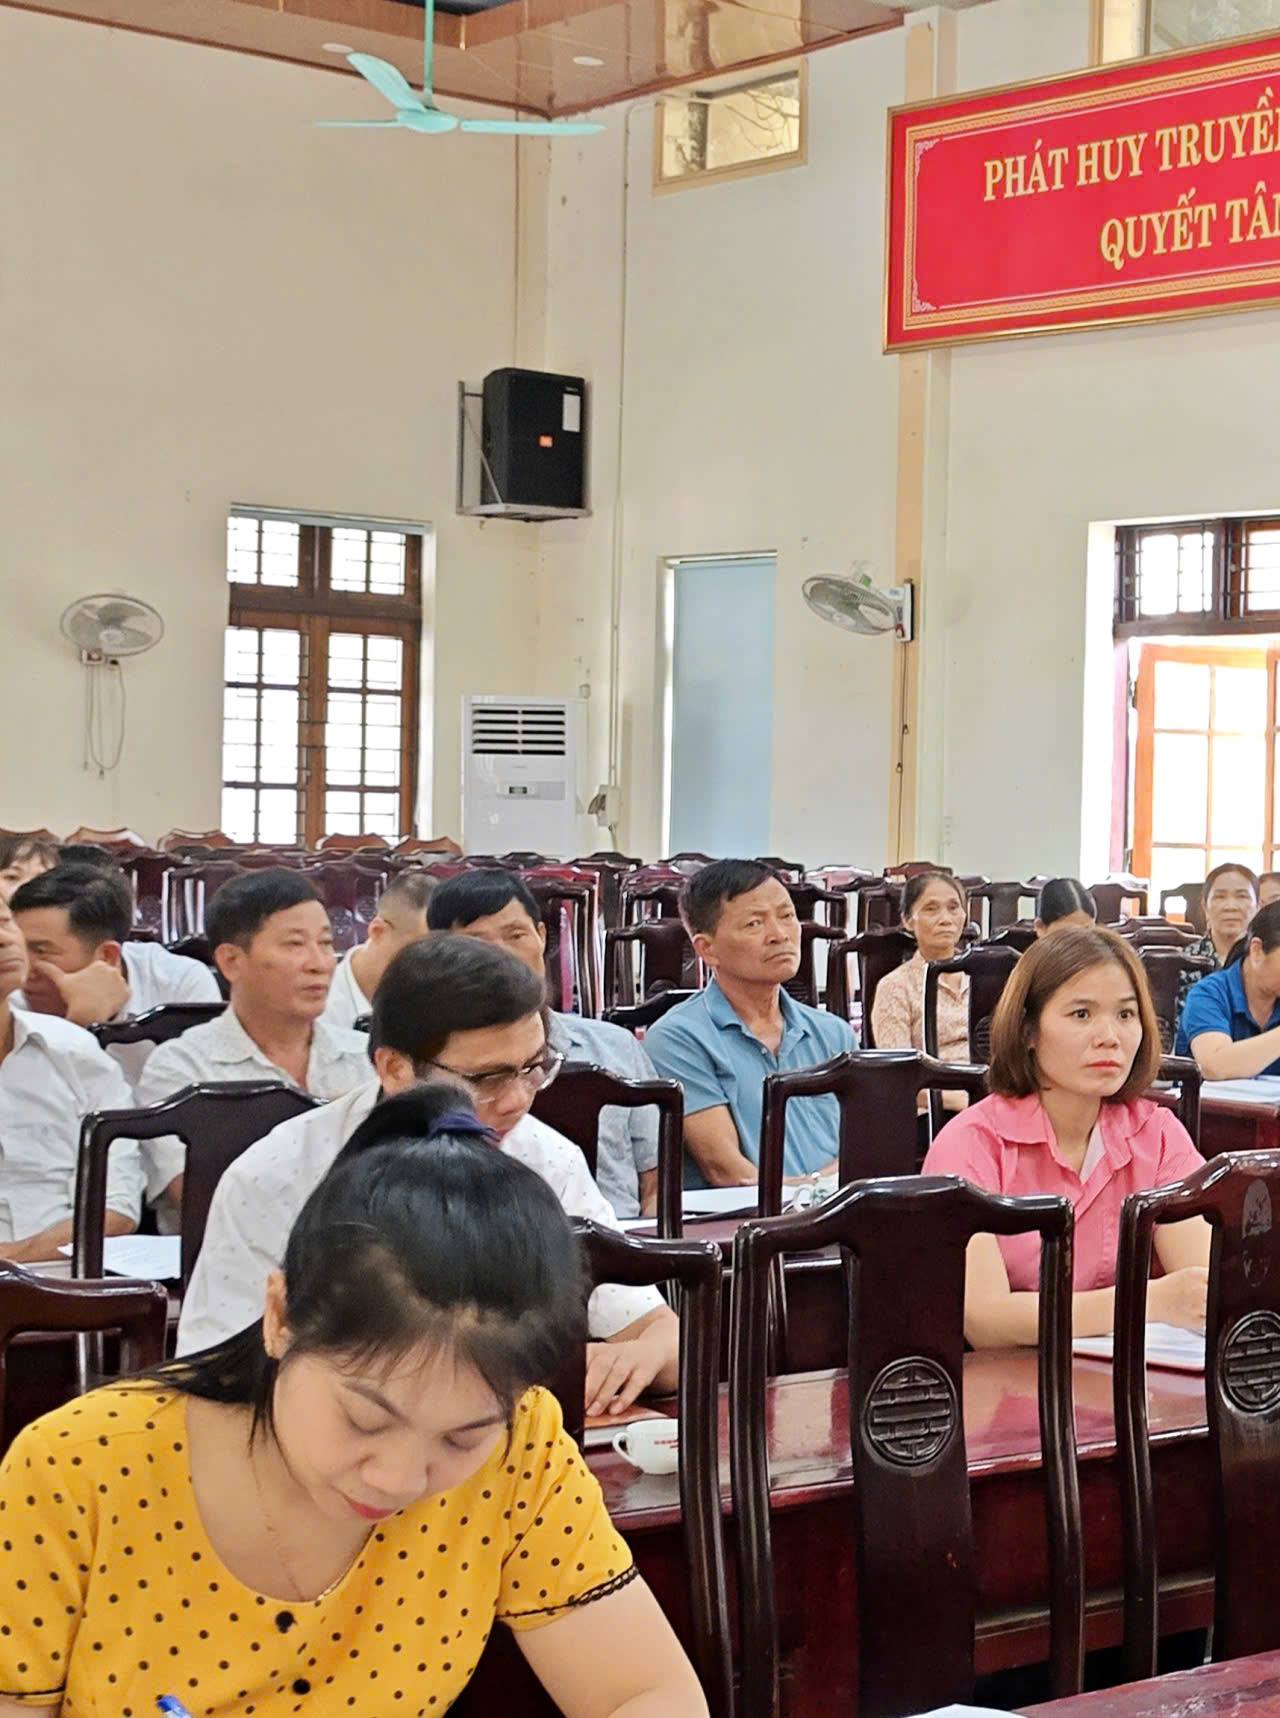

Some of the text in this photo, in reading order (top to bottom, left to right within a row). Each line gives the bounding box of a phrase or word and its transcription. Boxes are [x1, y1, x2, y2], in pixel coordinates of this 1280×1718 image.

[983, 139, 1069, 202] PHÁT
[1076, 133, 1148, 186] HUY
[1100, 187, 1217, 271] QUYẾT
